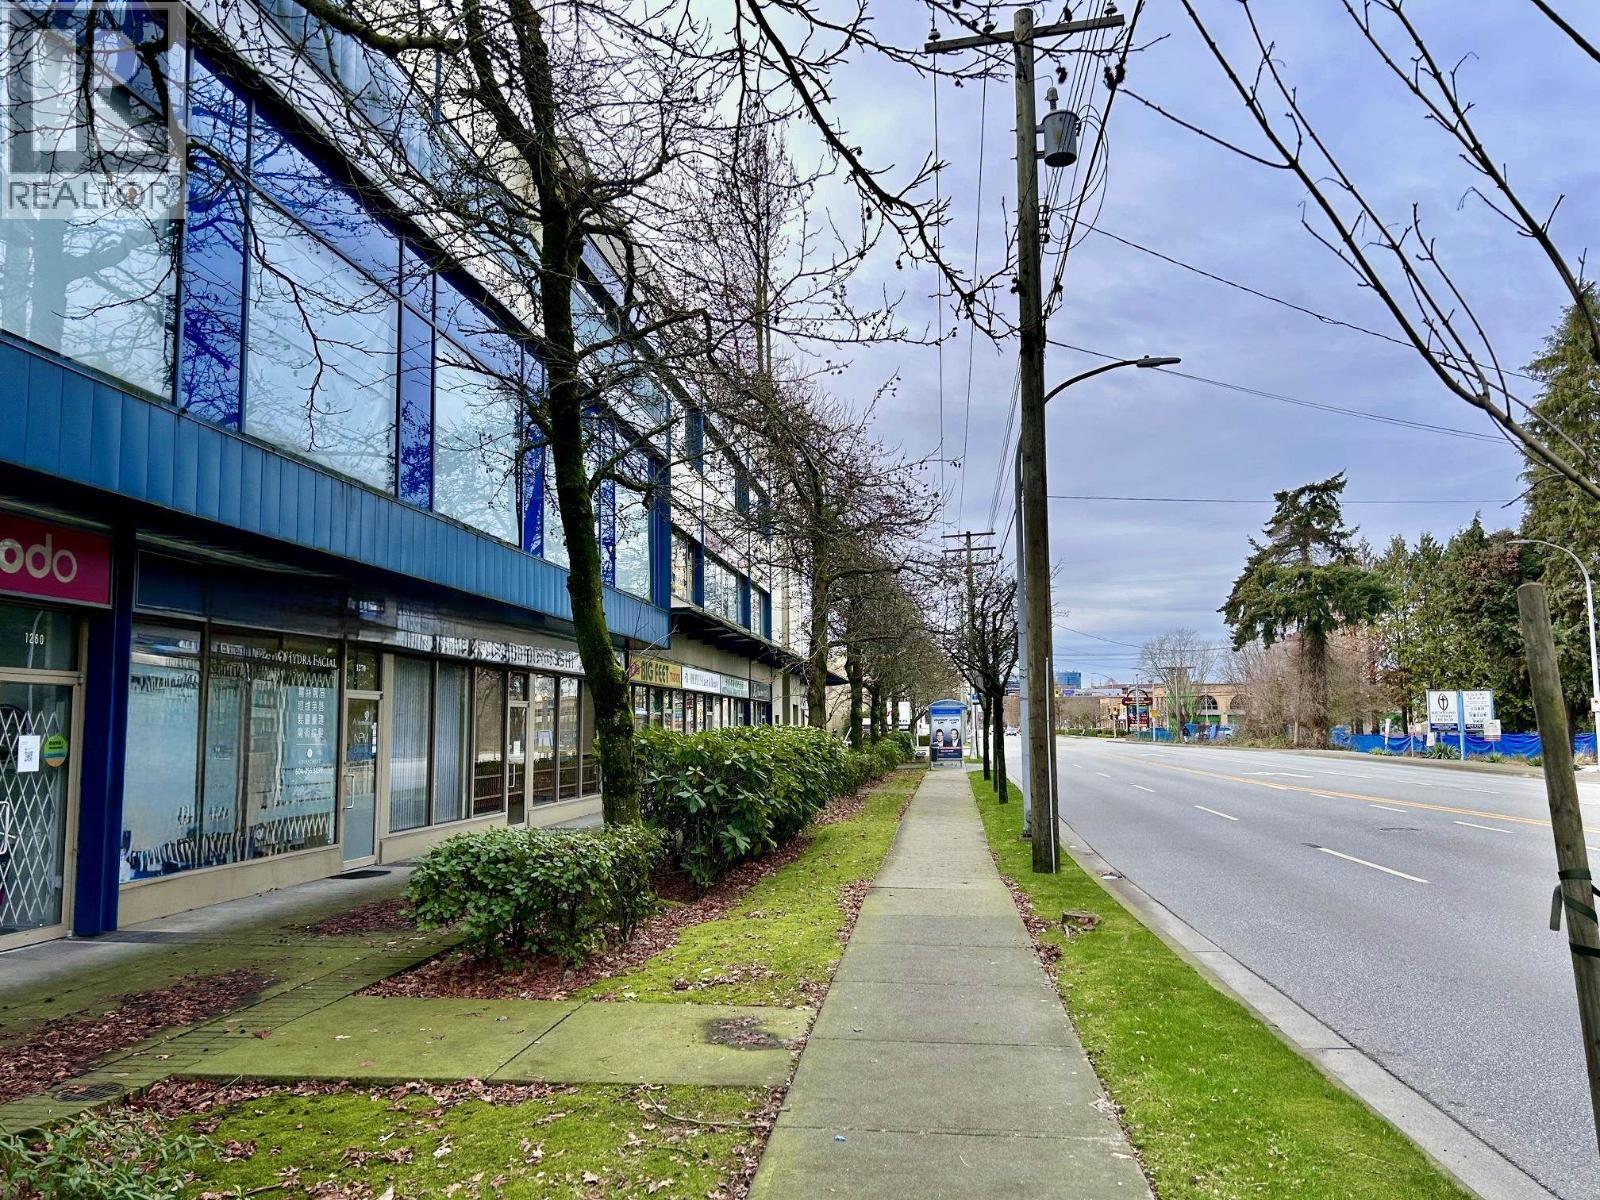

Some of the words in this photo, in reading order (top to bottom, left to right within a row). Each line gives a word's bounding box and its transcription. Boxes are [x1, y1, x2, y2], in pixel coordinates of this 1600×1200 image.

[25, 632, 45, 645] 1260
[312, 654, 338, 668] FACIAL
[640, 660, 654, 681] BIG
[654, 663, 669, 684] FEET
